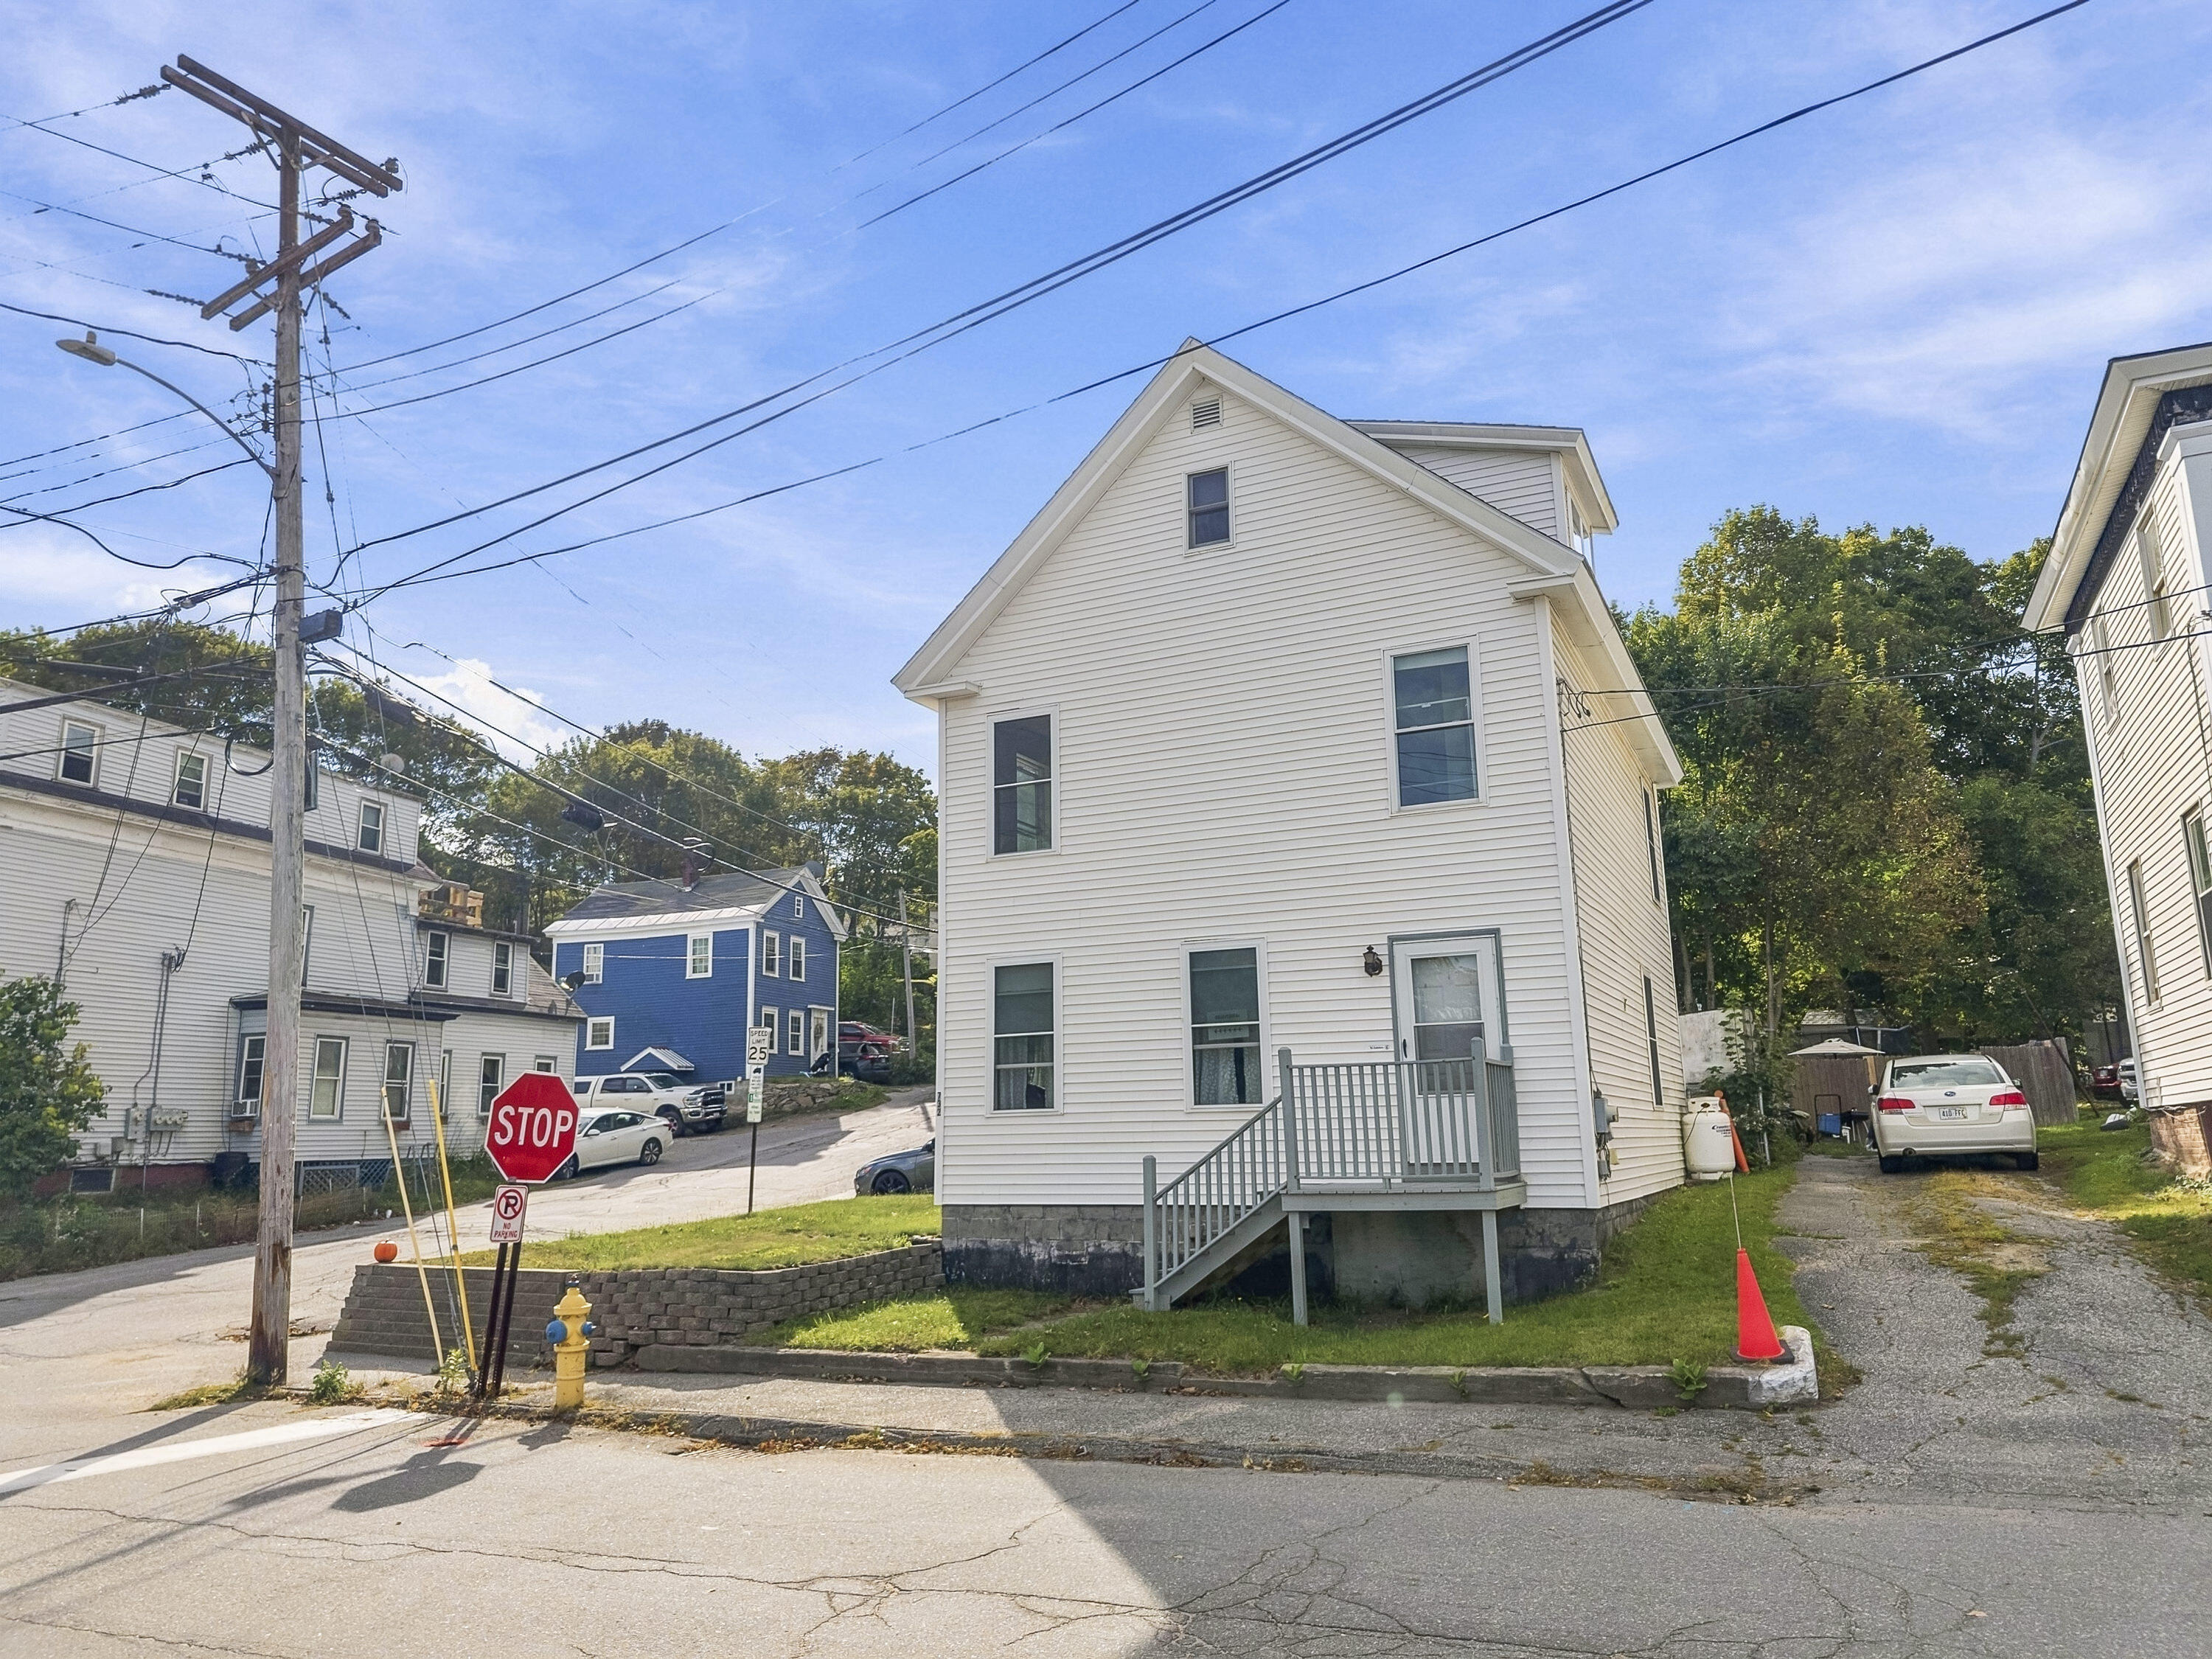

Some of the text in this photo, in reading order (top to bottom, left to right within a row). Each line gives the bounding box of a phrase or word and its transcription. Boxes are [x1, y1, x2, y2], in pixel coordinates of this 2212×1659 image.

[749, 1046, 767, 1060] 25
[494, 1105, 574, 1148] STOP
[503, 1222, 511, 1230] NO
[494, 1230, 518, 1238] PARKING
